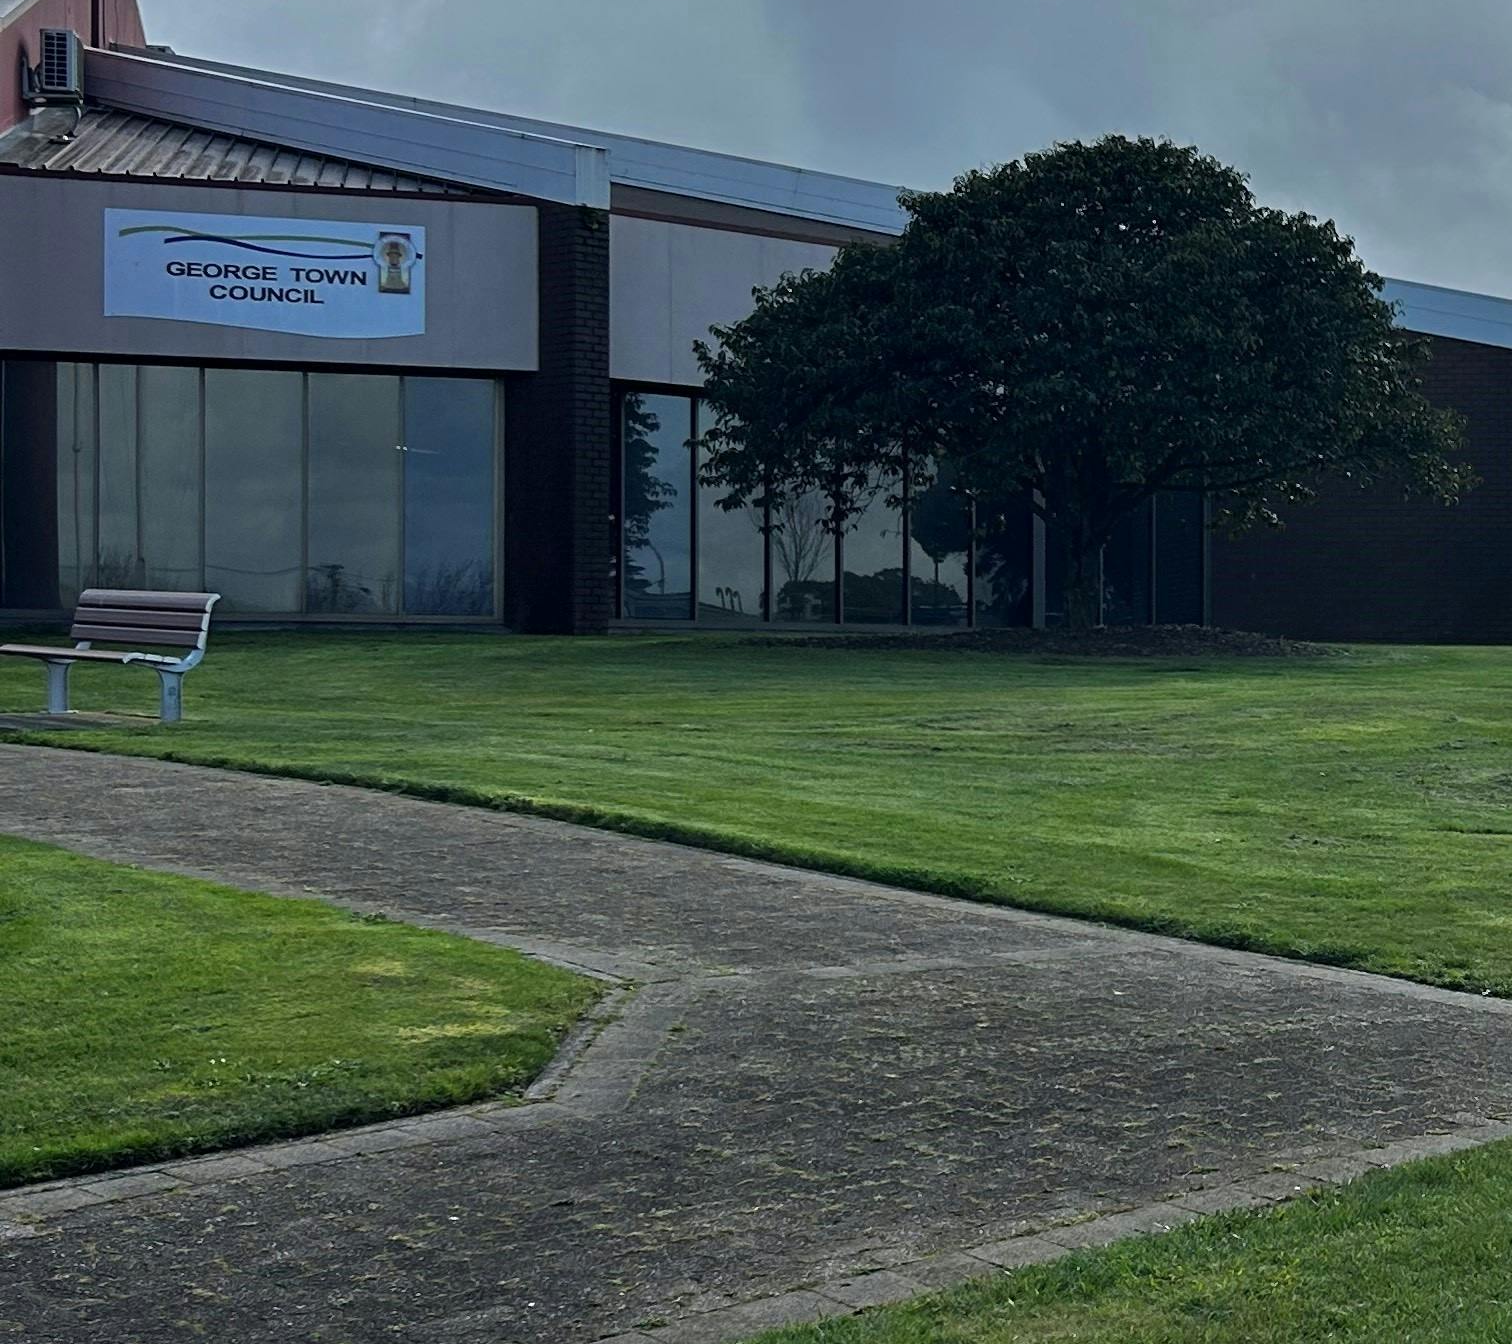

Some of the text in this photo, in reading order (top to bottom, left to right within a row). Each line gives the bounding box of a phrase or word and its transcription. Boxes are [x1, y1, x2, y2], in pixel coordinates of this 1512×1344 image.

[166, 261, 367, 286] GEORGE TOWN
[209, 284, 325, 304] COUNCIL
